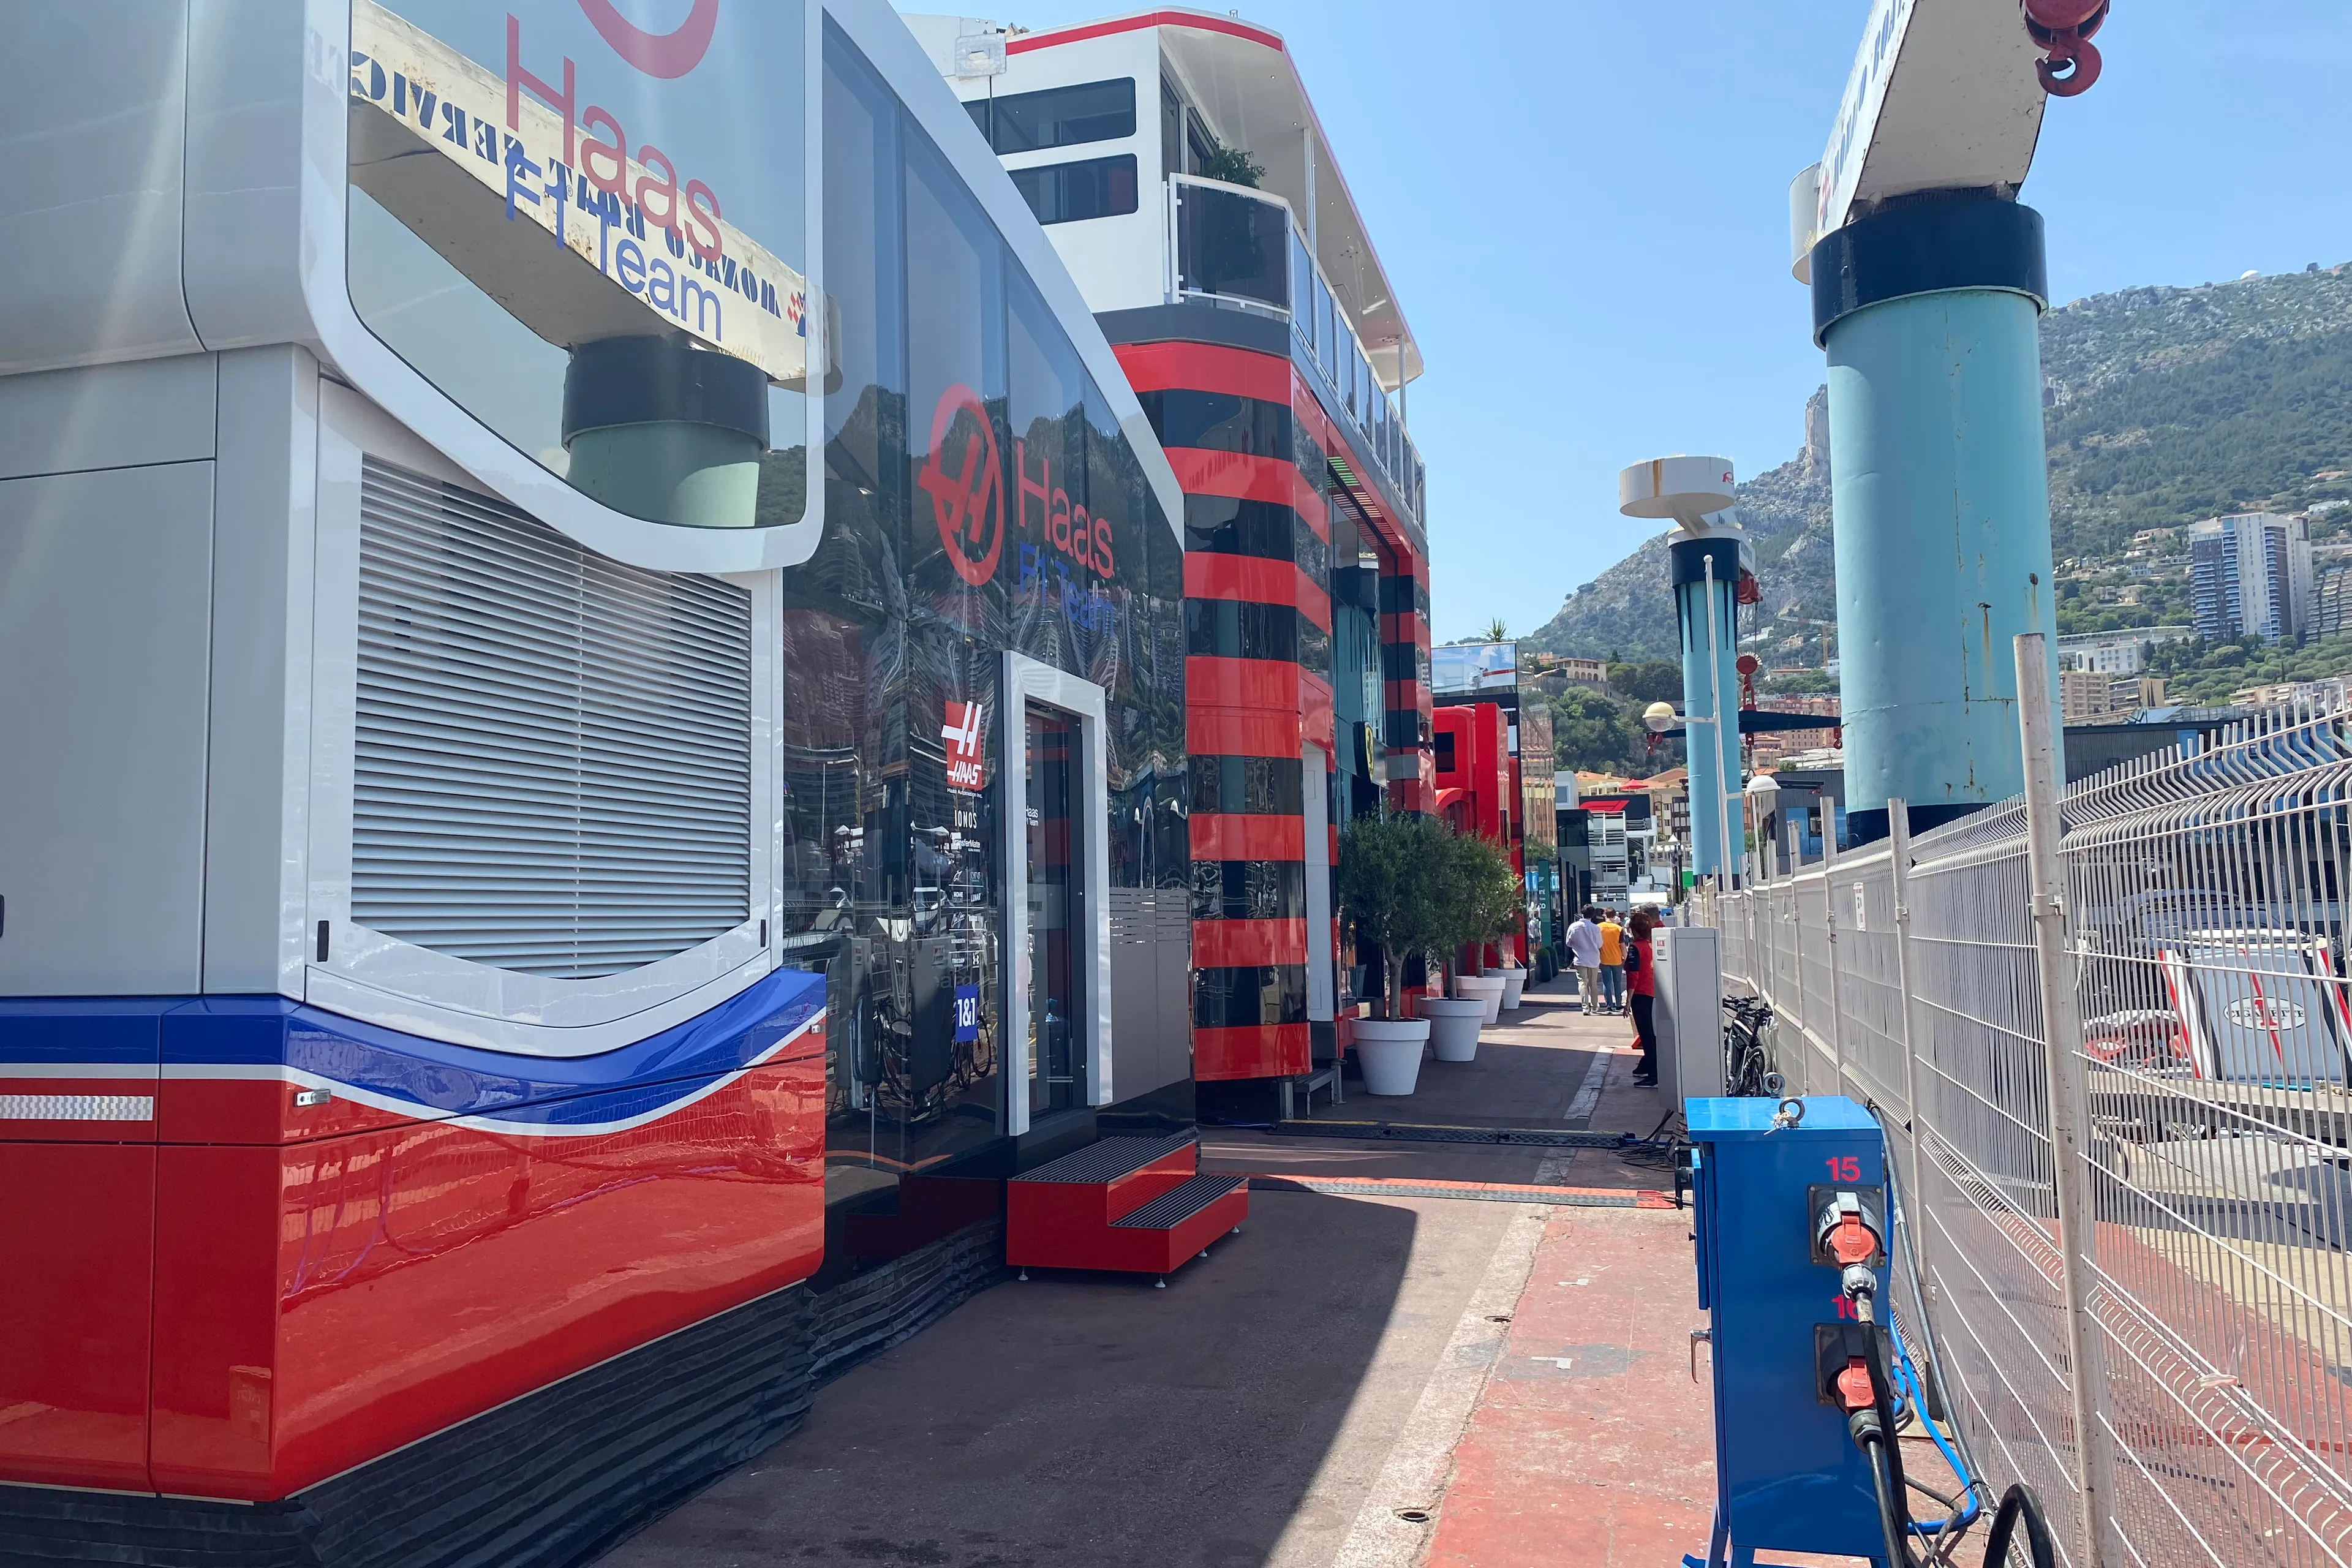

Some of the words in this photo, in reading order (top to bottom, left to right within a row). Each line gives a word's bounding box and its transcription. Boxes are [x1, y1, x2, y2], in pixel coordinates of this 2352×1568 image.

[507, 12, 722, 263] Haas
[505, 149, 564, 250] F1
[586, 196, 722, 342] Team
[1017, 440, 1115, 579] Haas
[1054, 559, 1114, 637] Team
[947, 760, 982, 785] HAAS
[954, 809, 978, 829] IONOS
[957, 997, 976, 1027] 1&1
[1826, 1156, 1860, 1182] 15
